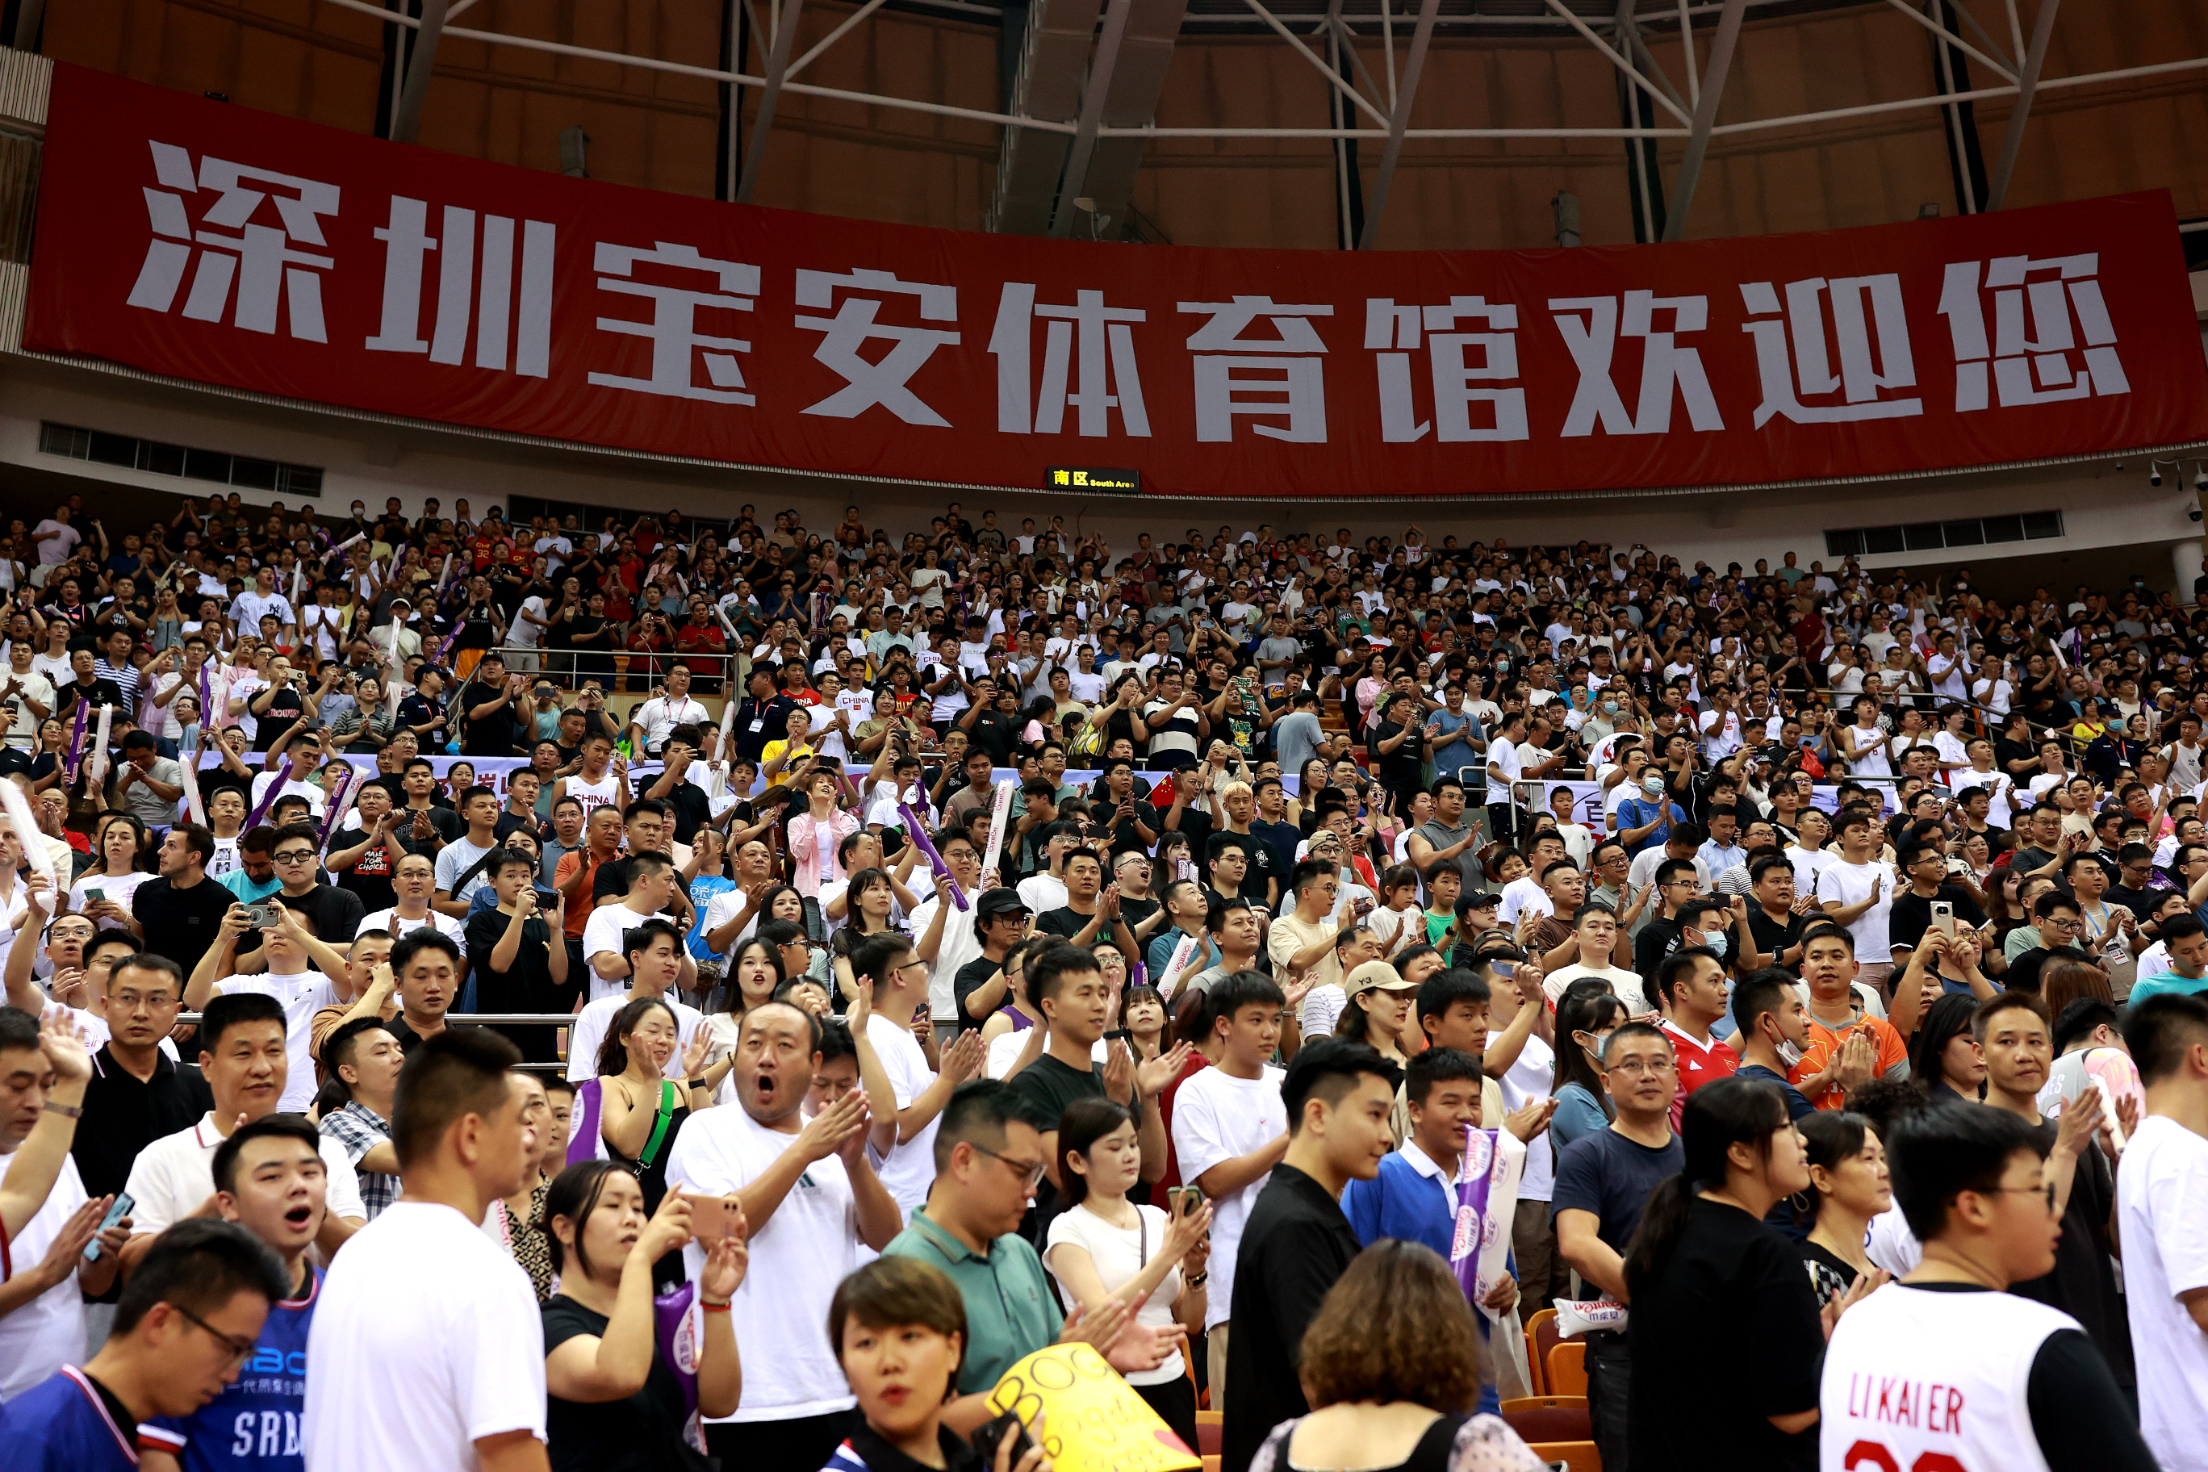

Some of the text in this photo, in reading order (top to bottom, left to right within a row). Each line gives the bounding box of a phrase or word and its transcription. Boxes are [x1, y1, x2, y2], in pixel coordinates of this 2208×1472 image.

[126, 139, 2132, 444] 深圳宝安体育馆欢迎您
[1054, 470, 1089, 486] 南区
[1090, 479, 1115, 488] South
[572, 793, 610, 805] CHINA
[363, 857, 383, 865] YOUR
[358, 863, 388, 872] CHOICE!
